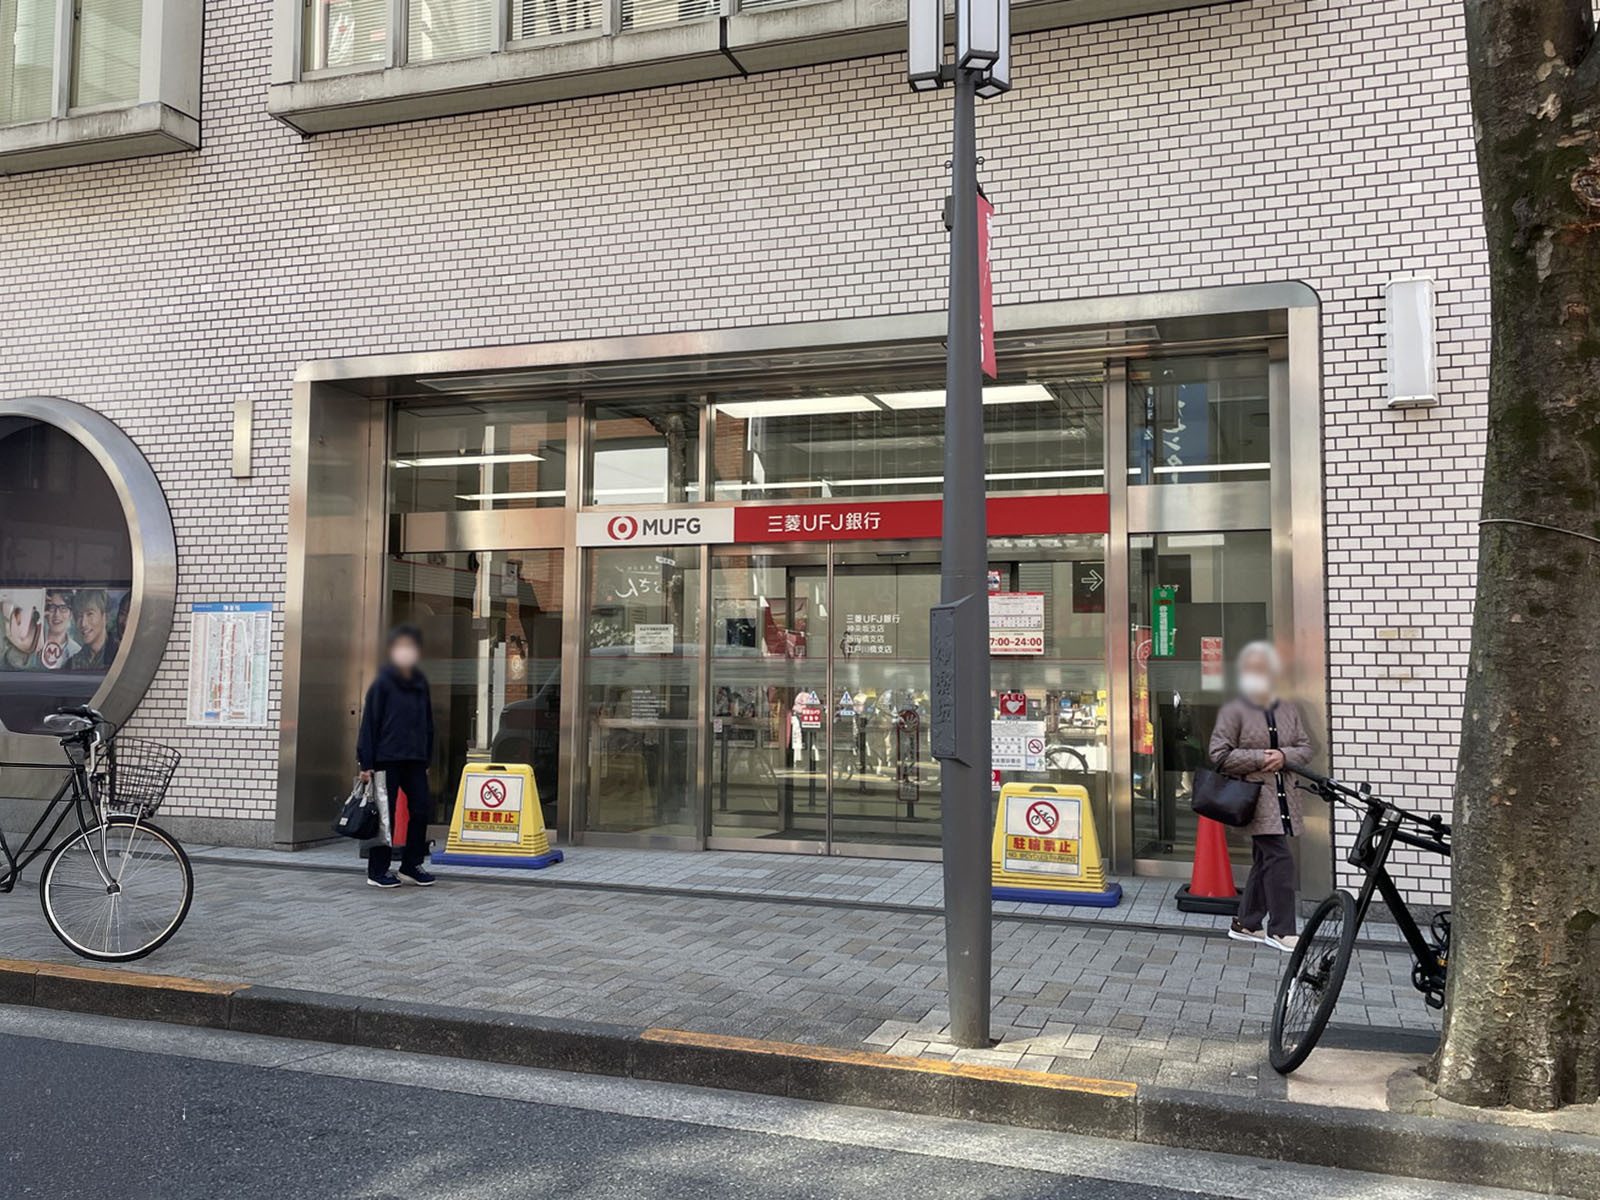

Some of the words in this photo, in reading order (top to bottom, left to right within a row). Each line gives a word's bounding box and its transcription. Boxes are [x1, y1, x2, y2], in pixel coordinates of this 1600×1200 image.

[642, 518, 701, 536] MUFG
[768, 512, 881, 532] 三菱UFJ銀行
[469, 811, 514, 824] 駐輪禁止
[1013, 837, 1071, 853] 駐輪禁止
